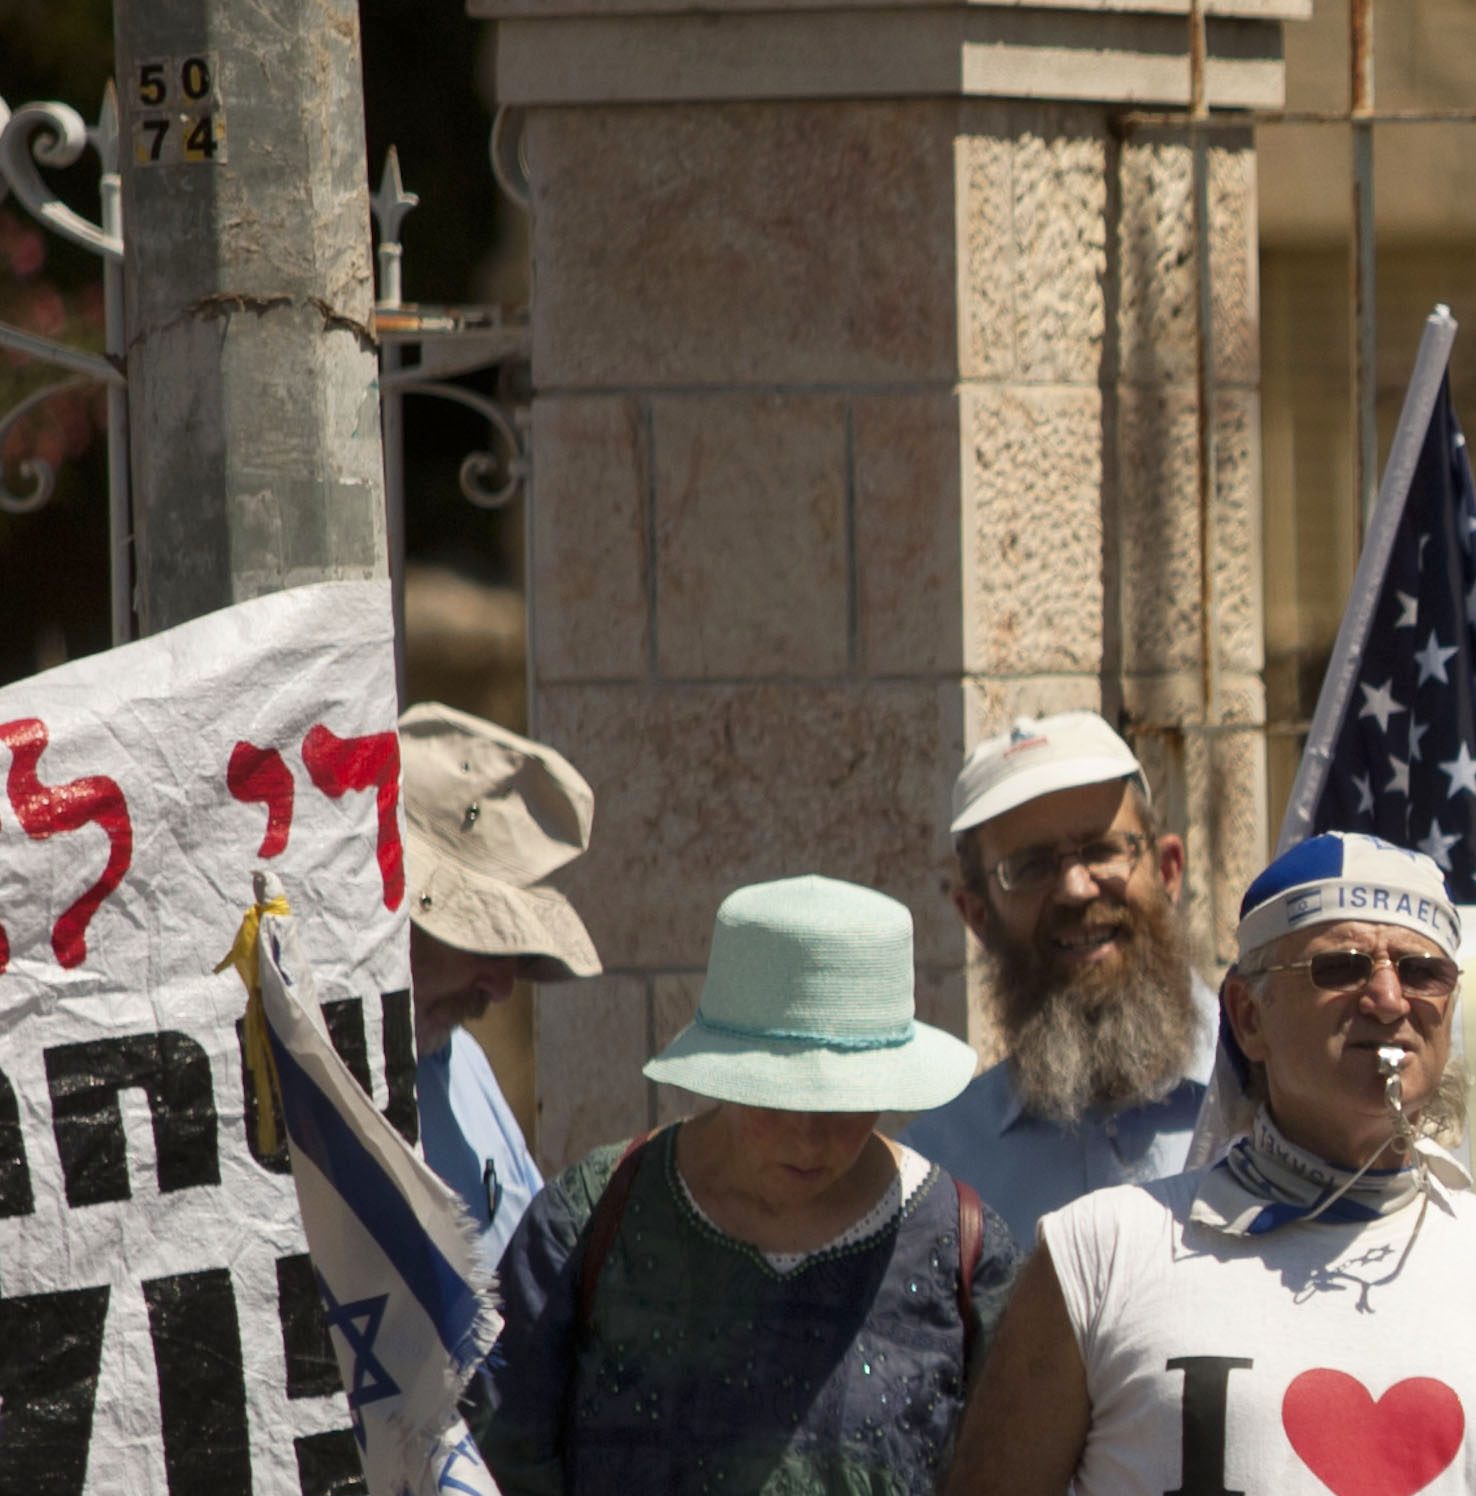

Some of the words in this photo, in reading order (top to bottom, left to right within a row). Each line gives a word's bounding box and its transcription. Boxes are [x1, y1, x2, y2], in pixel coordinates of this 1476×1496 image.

[142, 117, 218, 161] 74
[0, 717, 132, 970] ל
[1339, 886, 1441, 931] ISRAEL
